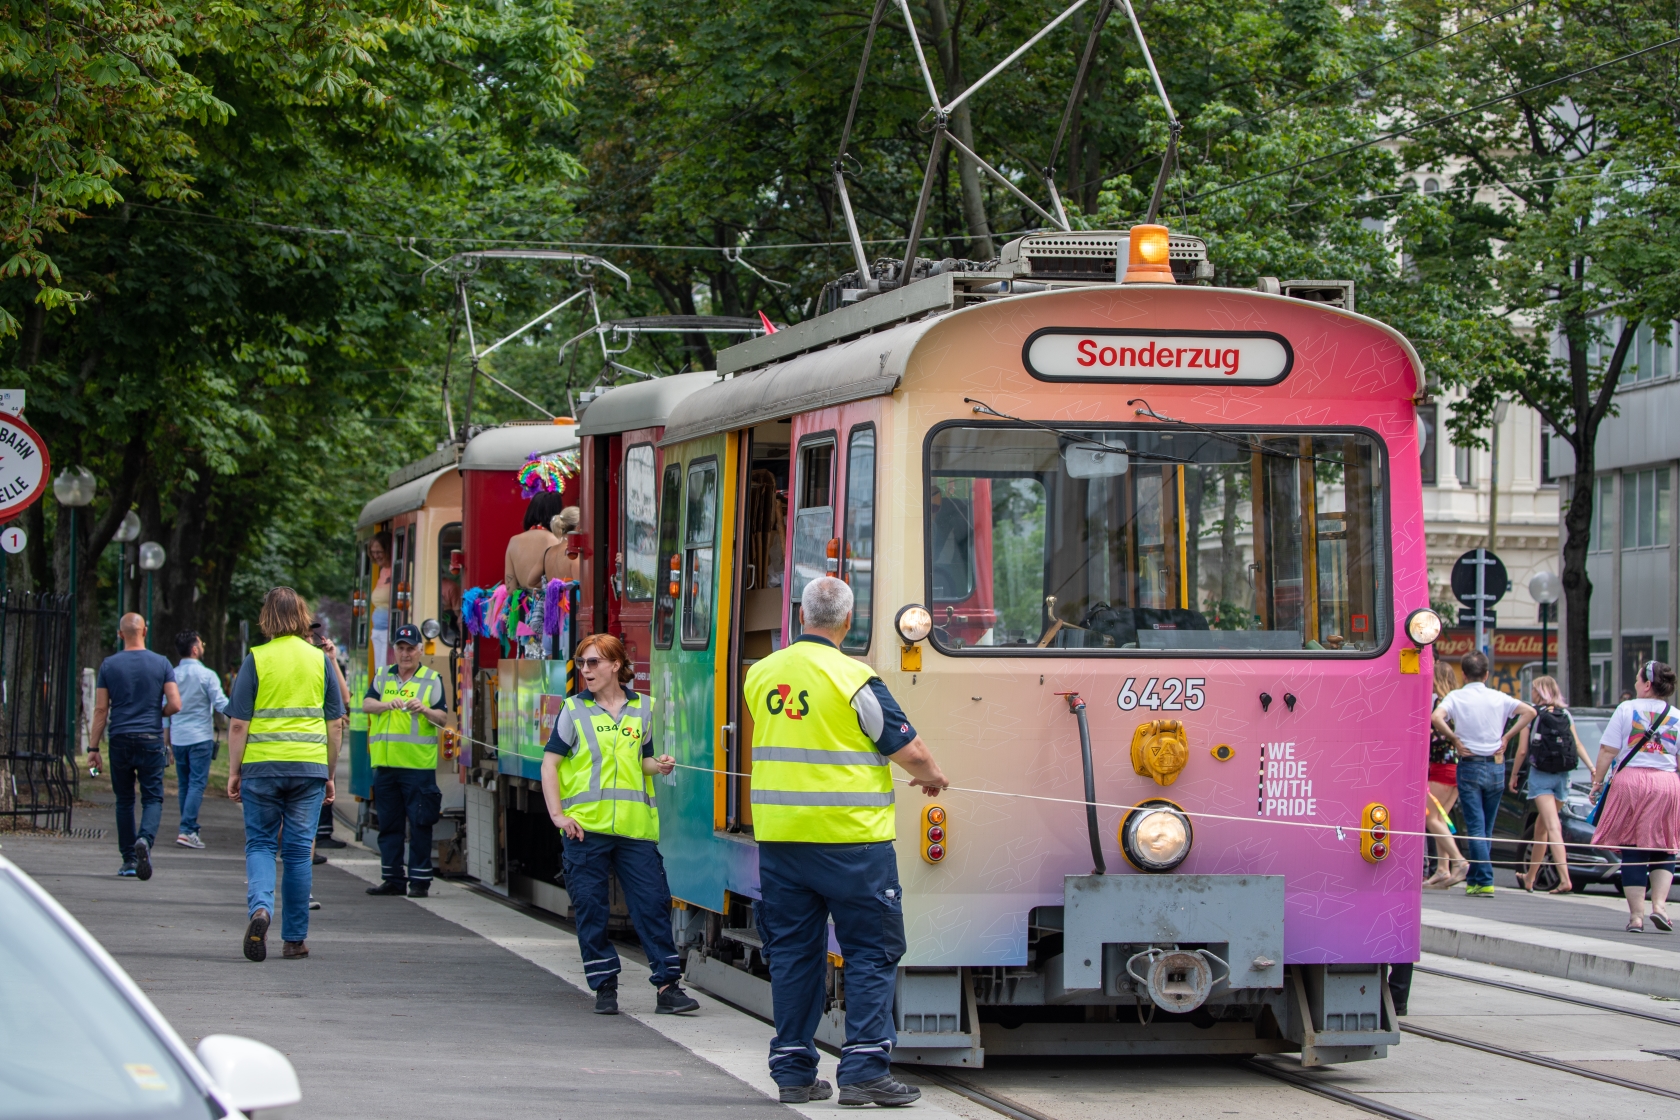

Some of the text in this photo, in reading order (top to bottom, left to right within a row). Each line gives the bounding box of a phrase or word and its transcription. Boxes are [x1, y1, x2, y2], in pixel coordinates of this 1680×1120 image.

[1076, 339, 1240, 375] Sonderzug
[10, 534, 17, 547] 1
[766, 684, 809, 720] G4S
[1117, 677, 1206, 711] 6425
[596, 723, 619, 733] 034
[1267, 742, 1295, 760] WE
[1267, 761, 1307, 779] RIDE
[1266, 780, 1312, 798] WITH
[1265, 798, 1317, 816] PRIDE
